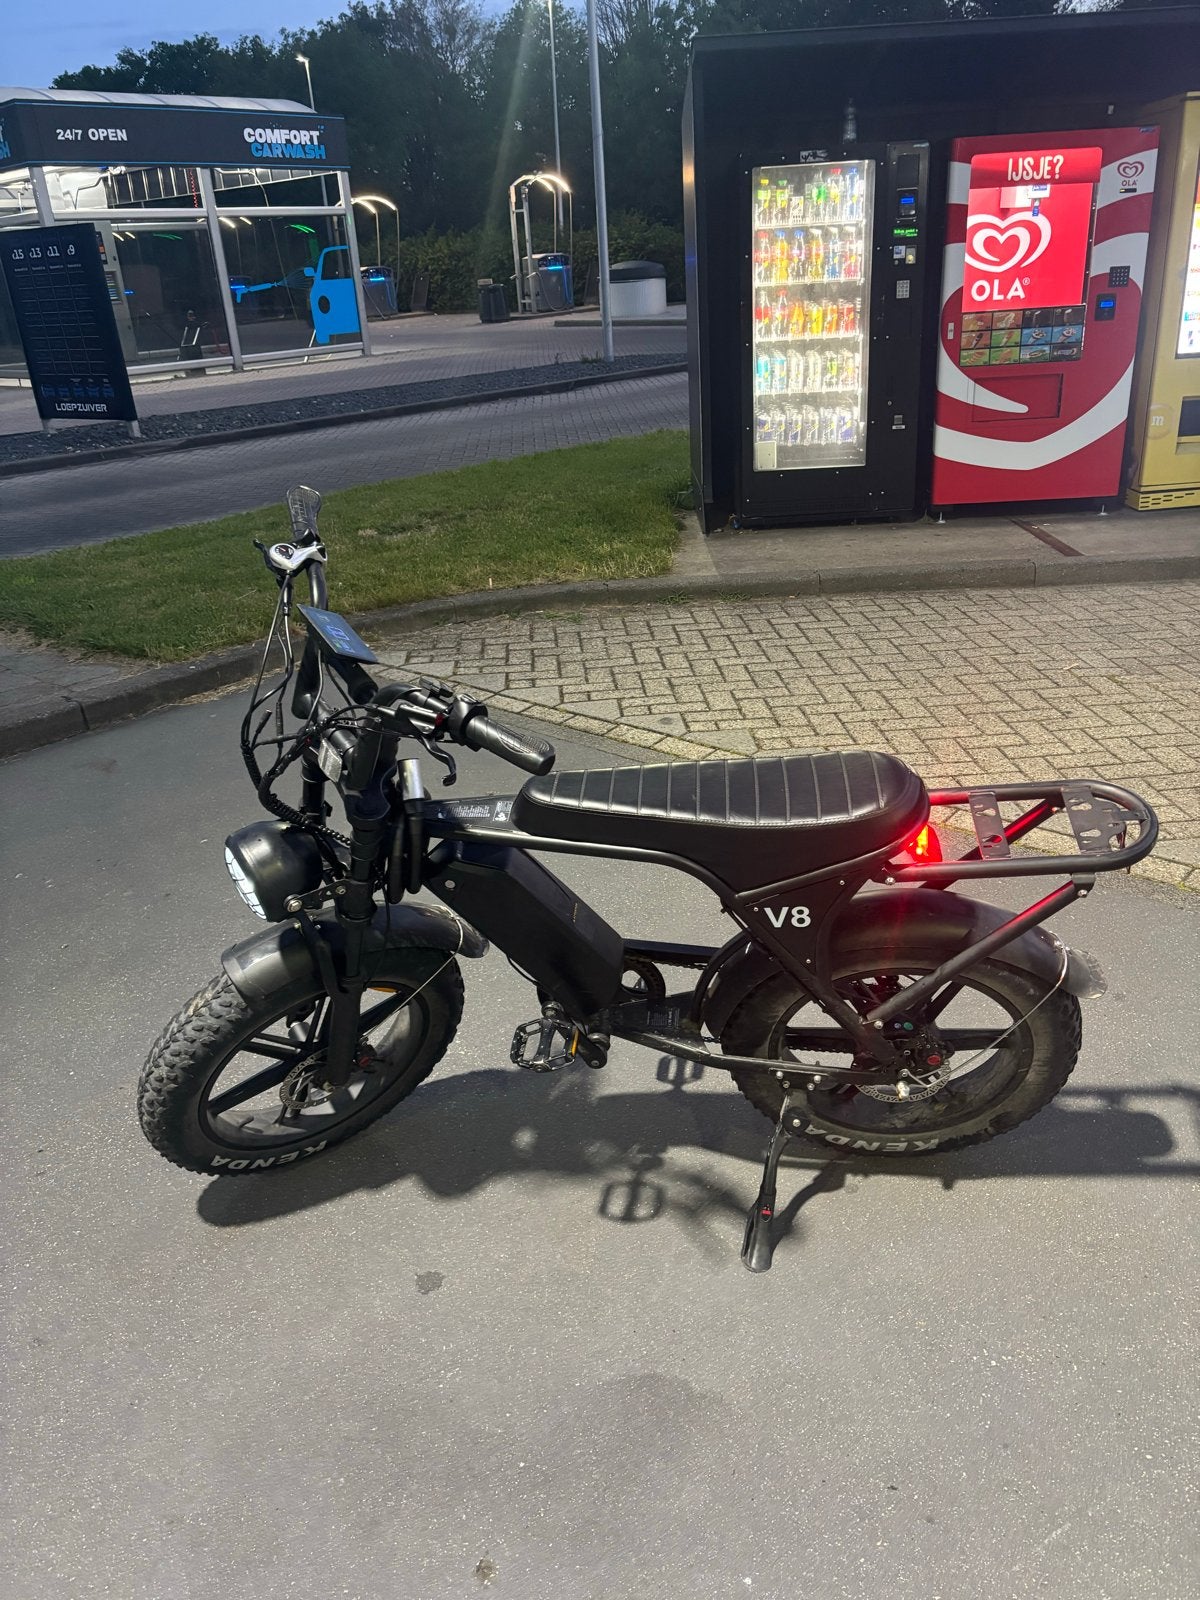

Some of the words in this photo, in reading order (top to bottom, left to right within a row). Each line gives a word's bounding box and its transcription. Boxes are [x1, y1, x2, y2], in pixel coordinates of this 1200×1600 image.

[87, 128, 128, 141] OPEN
[243, 127, 320, 146] COMFORT
[251, 142, 327, 160] CARWASH
[1007, 154, 1065, 182] IJSJE?
[763, 905, 812, 928] V8
[804, 1123, 940, 1152] KENDA
[210, 1140, 328, 1170] KENDA
